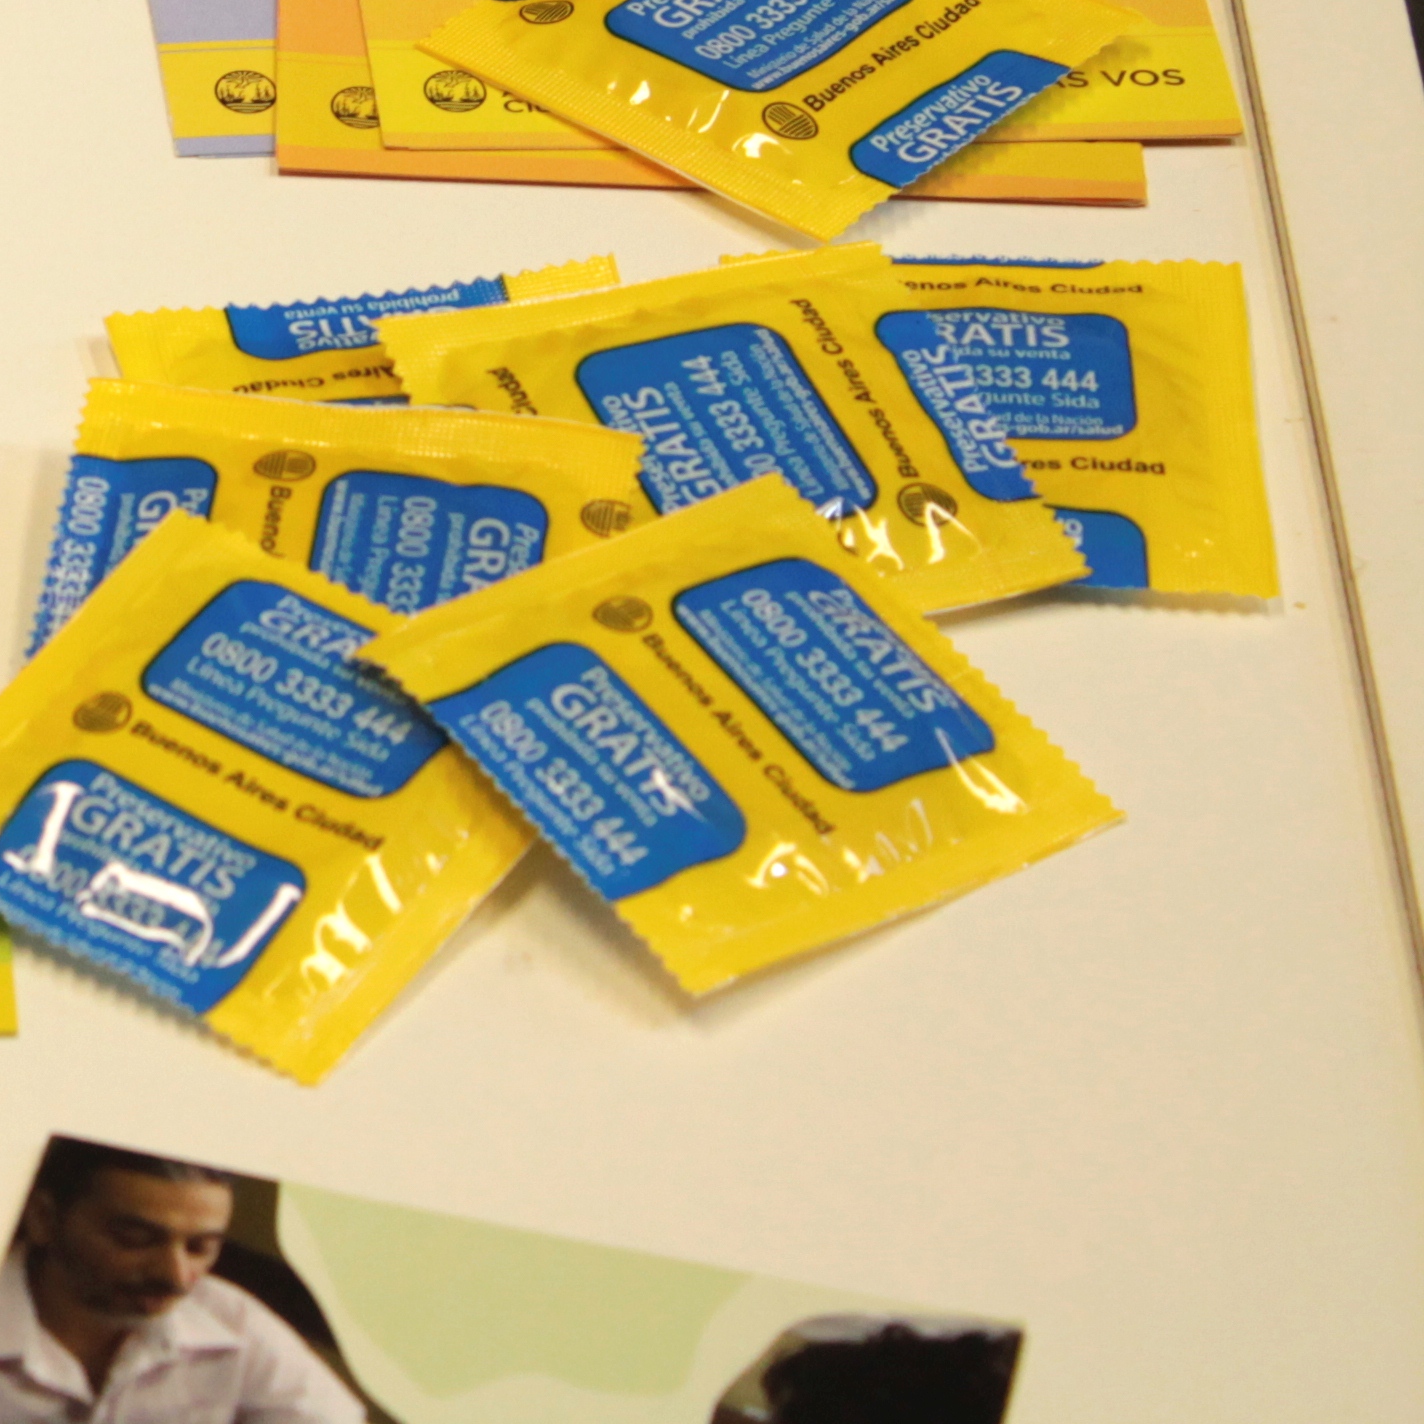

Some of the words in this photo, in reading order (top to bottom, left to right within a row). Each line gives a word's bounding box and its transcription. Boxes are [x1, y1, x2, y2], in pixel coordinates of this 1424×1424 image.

[694, 24, 756, 61] 0800
[722, 42, 770, 70] Línea
[804, 63, 877, 113] Buenos
[872, 33, 920, 67] Aires
[869, 73, 992, 153] Preservativo
[897, 80, 1024, 165] GRATIS
[975, 277, 1042, 293] Aires
[1050, 283, 1144, 295] Ciudad
[681, 354, 727, 396] 444
[1014, 347, 1071, 360] venta
[1041, 369, 1099, 393] 444
[708, 399, 764, 452] 3333
[902, 349, 989, 473] Preservativo
[921, 343, 1018, 468] GRATIS
[1051, 392, 1100, 409] Sida
[868, 406, 920, 478] Buenos
[1070, 457, 1166, 475] Ciudad
[395, 496, 438, 558] 0800
[201, 631, 278, 683] 0800
[274, 668, 354, 719] 3333
[741, 588, 808, 648] 0800
[796, 647, 864, 706] 3333
[480, 700, 548, 763] 0800
[70, 795, 236, 900] GRATIS
[90, 770, 258, 872] Preservativo
